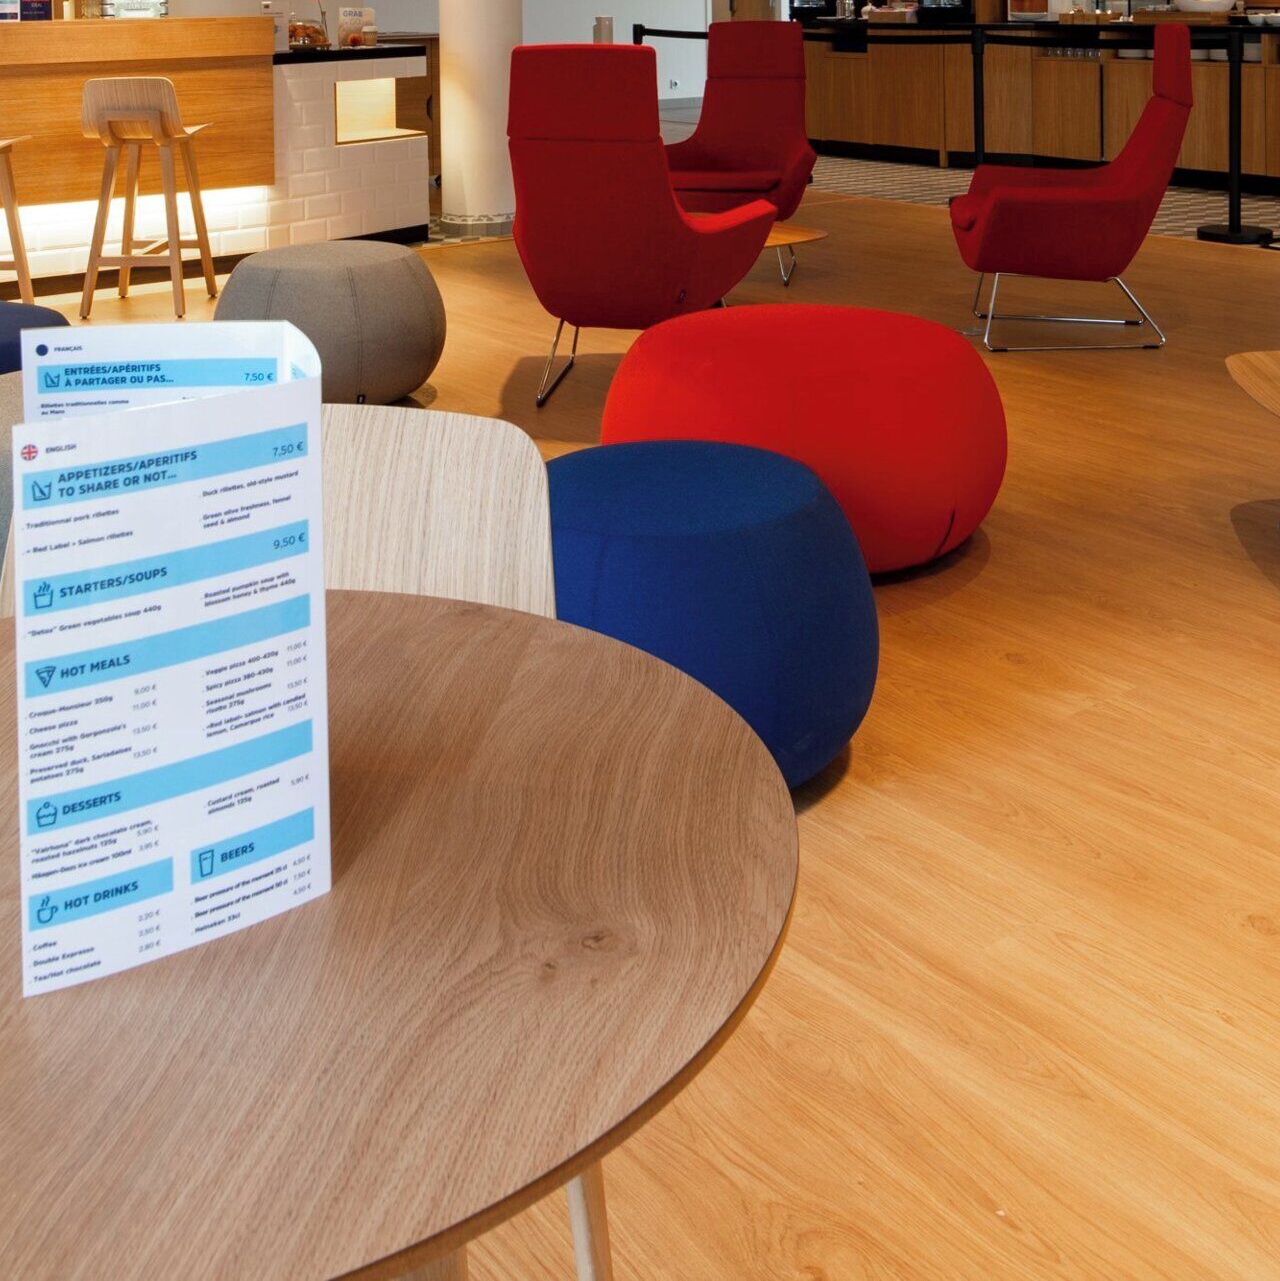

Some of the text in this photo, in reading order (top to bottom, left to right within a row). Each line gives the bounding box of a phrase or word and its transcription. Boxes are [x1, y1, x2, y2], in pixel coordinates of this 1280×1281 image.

[64, 363, 161, 376] ENTRÉES/APÉRITIFS
[244, 373, 265, 381] 7,50
[75, 376, 127, 387] PARTAGER
[130, 376, 144, 384] OU
[45, 444, 77, 453] ENGLISH
[273, 445, 294, 457] 7,50
[58, 451, 197, 483] APPETIZERS/APERITIFS
[58, 487, 75, 498] TO
[80, 479, 119, 495] SHARE
[123, 476, 139, 487] OR
[273, 535, 295, 549] 9,50
[59, 567, 168, 598] STARTERS/SOUPS
[60, 655, 131, 679] HOT MEALS
[62, 791, 121, 815] DESSERTS
[221, 842, 255, 862] BEERS
[64, 881, 139, 910] HOT DRINKS
